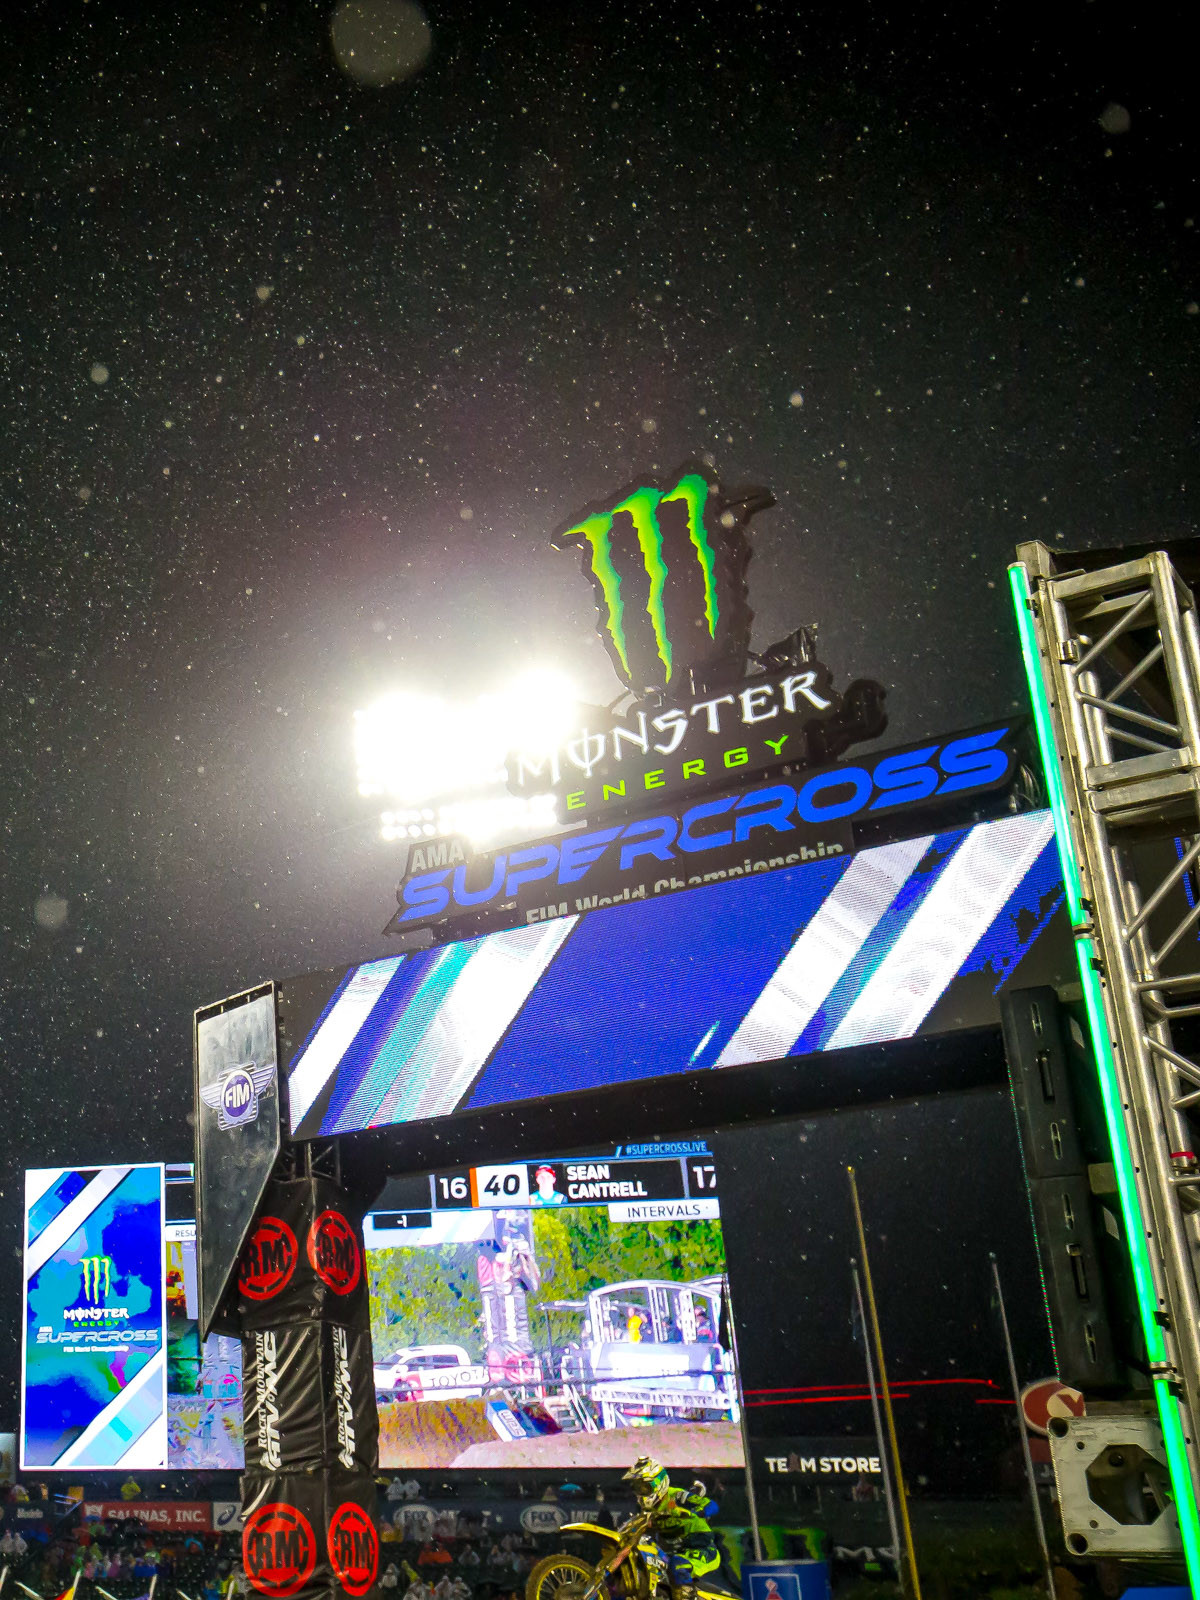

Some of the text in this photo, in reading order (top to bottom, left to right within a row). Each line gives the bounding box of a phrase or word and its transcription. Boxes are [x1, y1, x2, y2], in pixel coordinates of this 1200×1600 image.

[515, 671, 831, 788] MONSTER
[566, 735, 789, 811] ENERGY
[399, 728, 1009, 921] SUPERCROSS
[411, 840, 465, 873] AMA
[526, 903, 568, 925] FIM
[576, 884, 645, 911] World
[225, 1083, 250, 1108] FIM
[626, 1141, 707, 1155] #SUPERCROSSLIVE
[566, 1165, 610, 1181] SEAN
[439, 1177, 468, 1199] 16
[484, 1174, 521, 1196] 40
[567, 1182, 648, 1199] CANTRELL
[627, 1203, 701, 1219] INTERVALS
[63, 1306, 130, 1321] MONSTER
[36, 1329, 159, 1344] SUPERCROSS
[256, 1331, 267, 1448] ROCKY MOUNTAIN
[333, 1326, 346, 1444] ROCKY MOUNTAIN
[819, 1456, 882, 1474] STORE
[175, 1510, 206, 1523] INC.
[531, 1511, 556, 1523] FOX
[256, 1530, 301, 1570] RM
